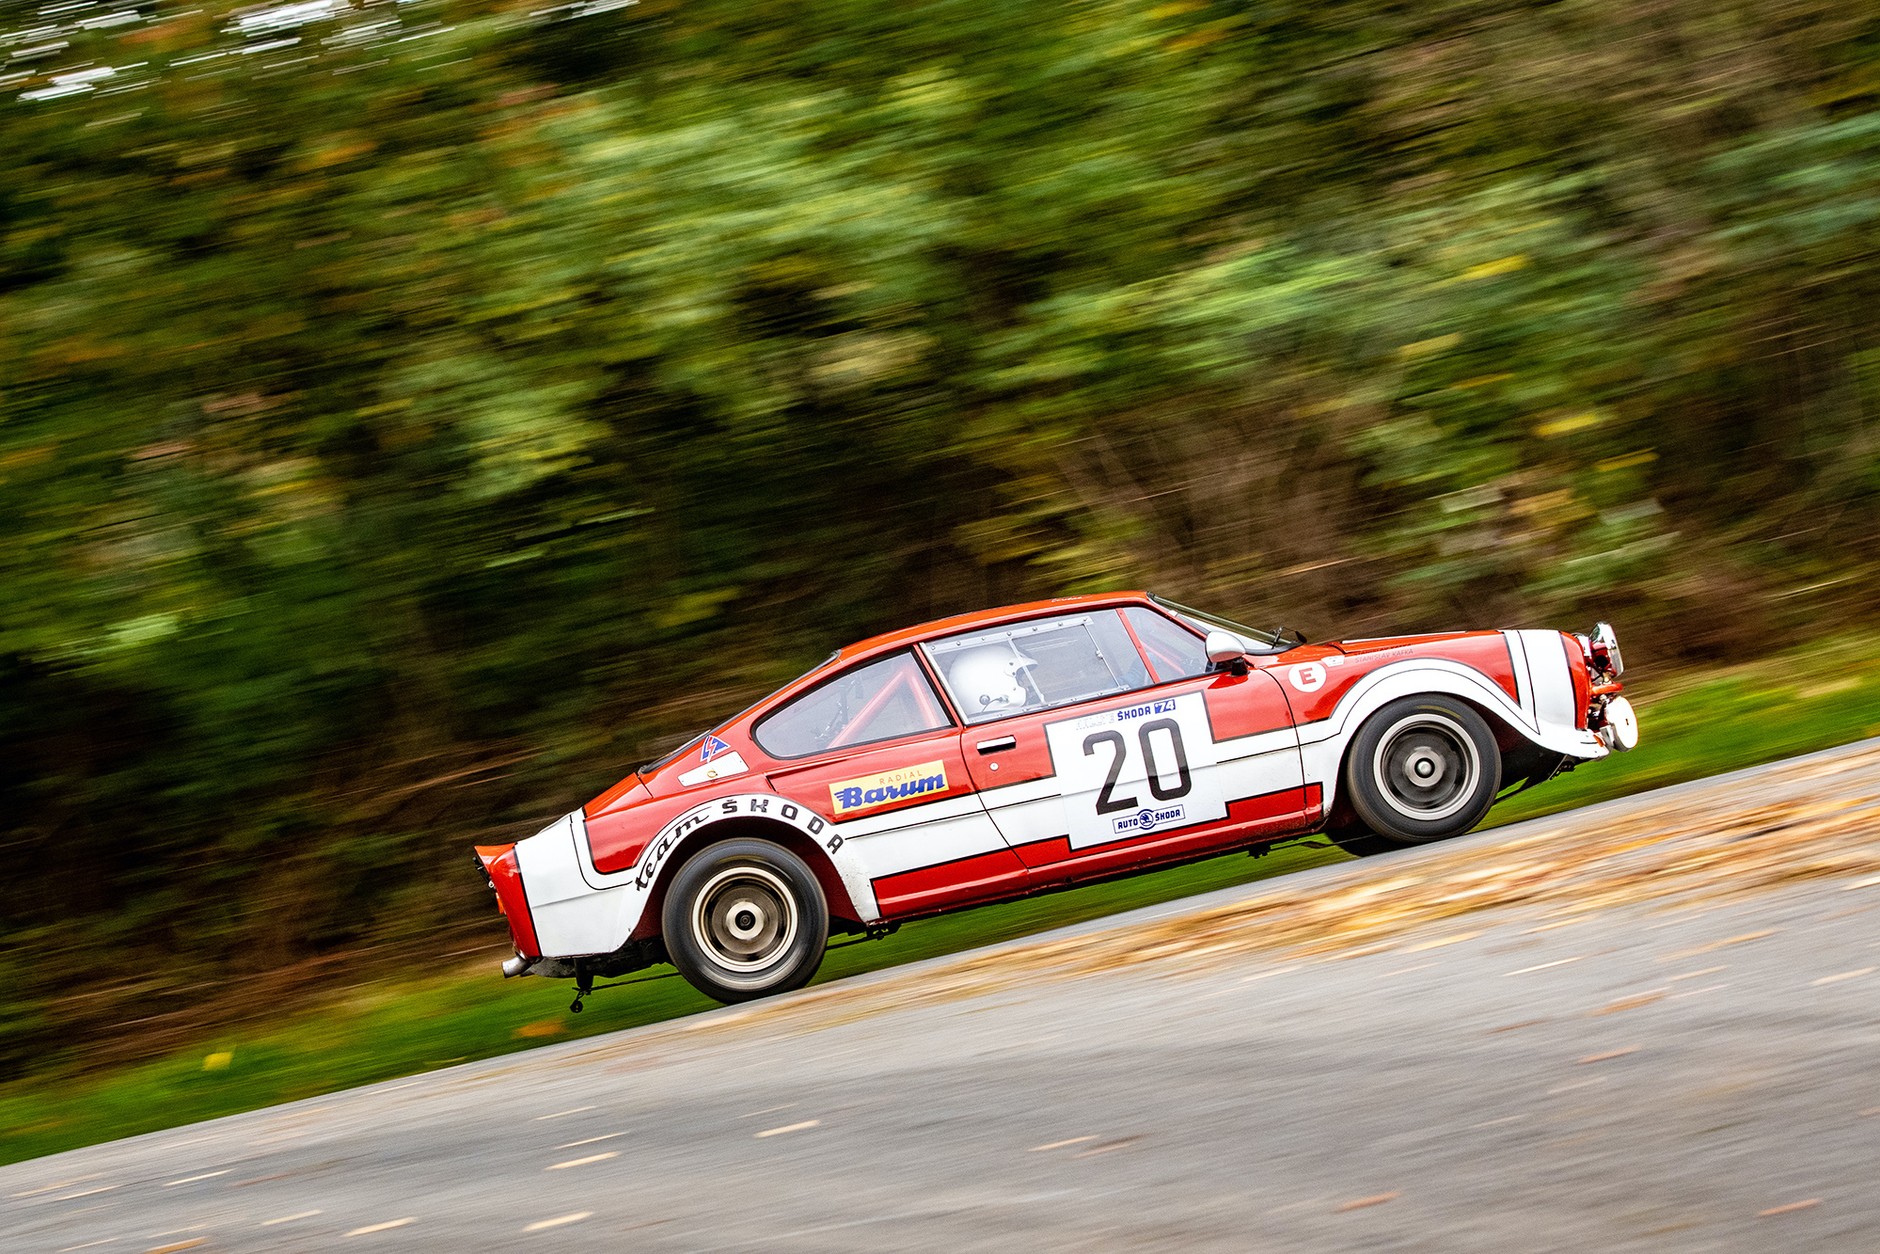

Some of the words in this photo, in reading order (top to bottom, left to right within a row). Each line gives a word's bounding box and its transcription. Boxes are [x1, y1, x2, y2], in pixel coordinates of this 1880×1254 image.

[1392, 648, 1414, 659] KAFKA
[1298, 667, 1317, 685] E
[1117, 705, 1151, 721] ŠKODA
[1082, 717, 1192, 816] 20
[879, 770, 923, 785] RADIAL
[836, 773, 945, 809] Barum
[1117, 817, 1139, 830] AUTO
[1154, 808, 1181, 822] ŠKODA
[634, 805, 712, 892] team
[721, 798, 846, 855] ŠKODA
